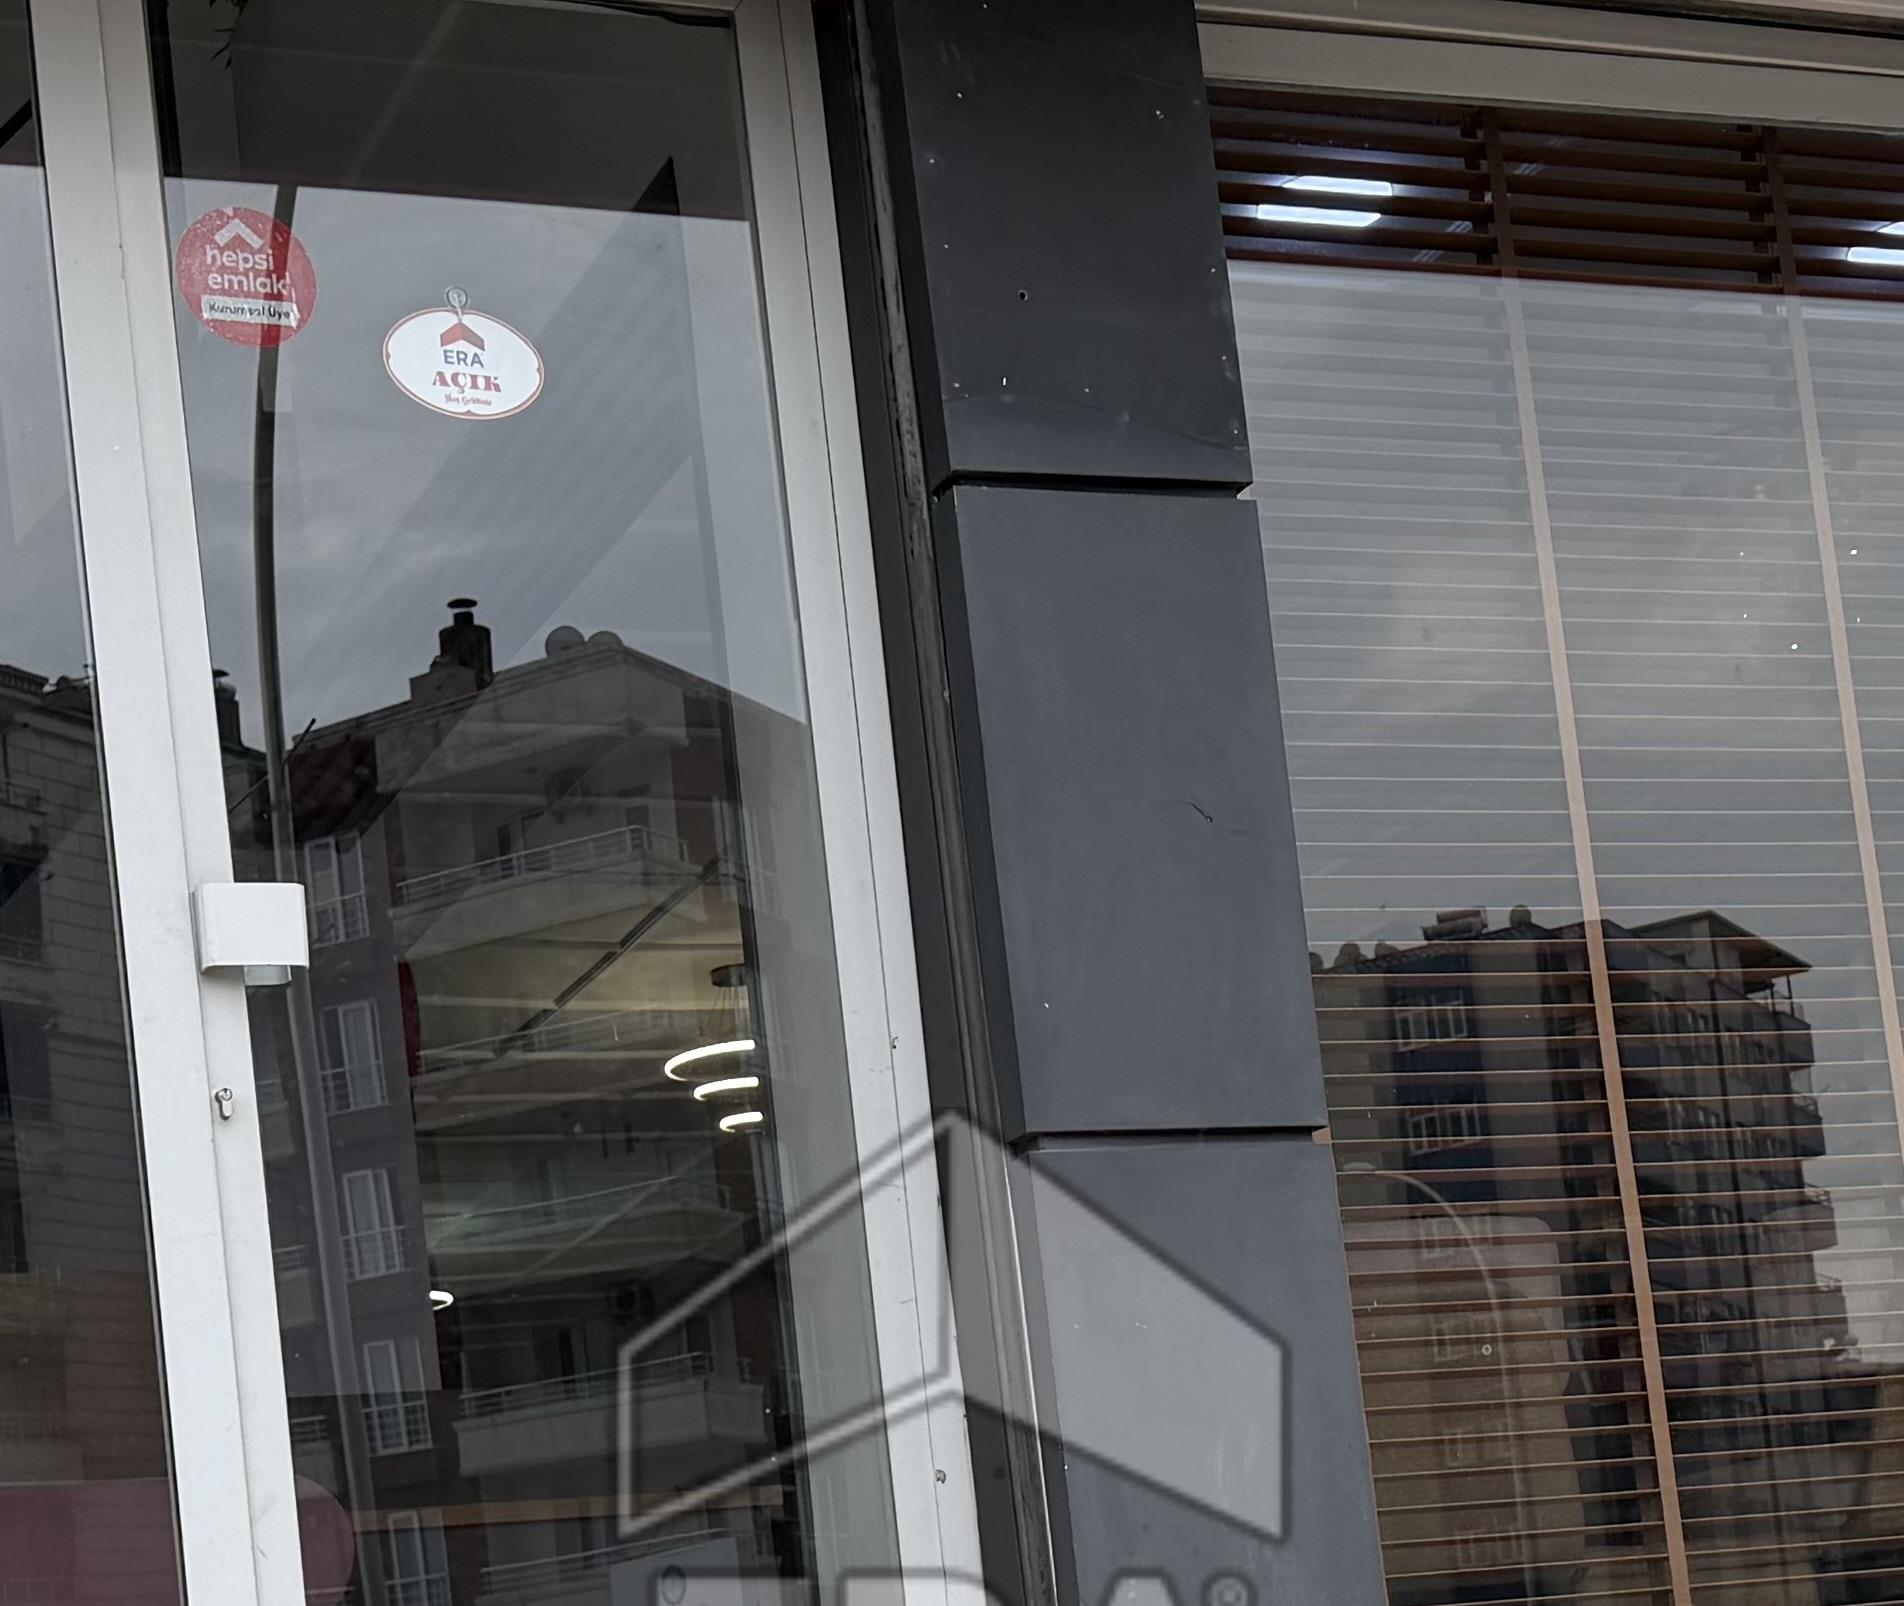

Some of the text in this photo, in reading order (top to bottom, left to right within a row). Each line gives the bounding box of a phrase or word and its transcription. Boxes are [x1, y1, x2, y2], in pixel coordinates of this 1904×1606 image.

[205, 245, 274, 271] hepsi
[207, 271, 291, 295] emlak
[443, 349, 484, 368] ERA
[432, 371, 502, 394] AÇIK
